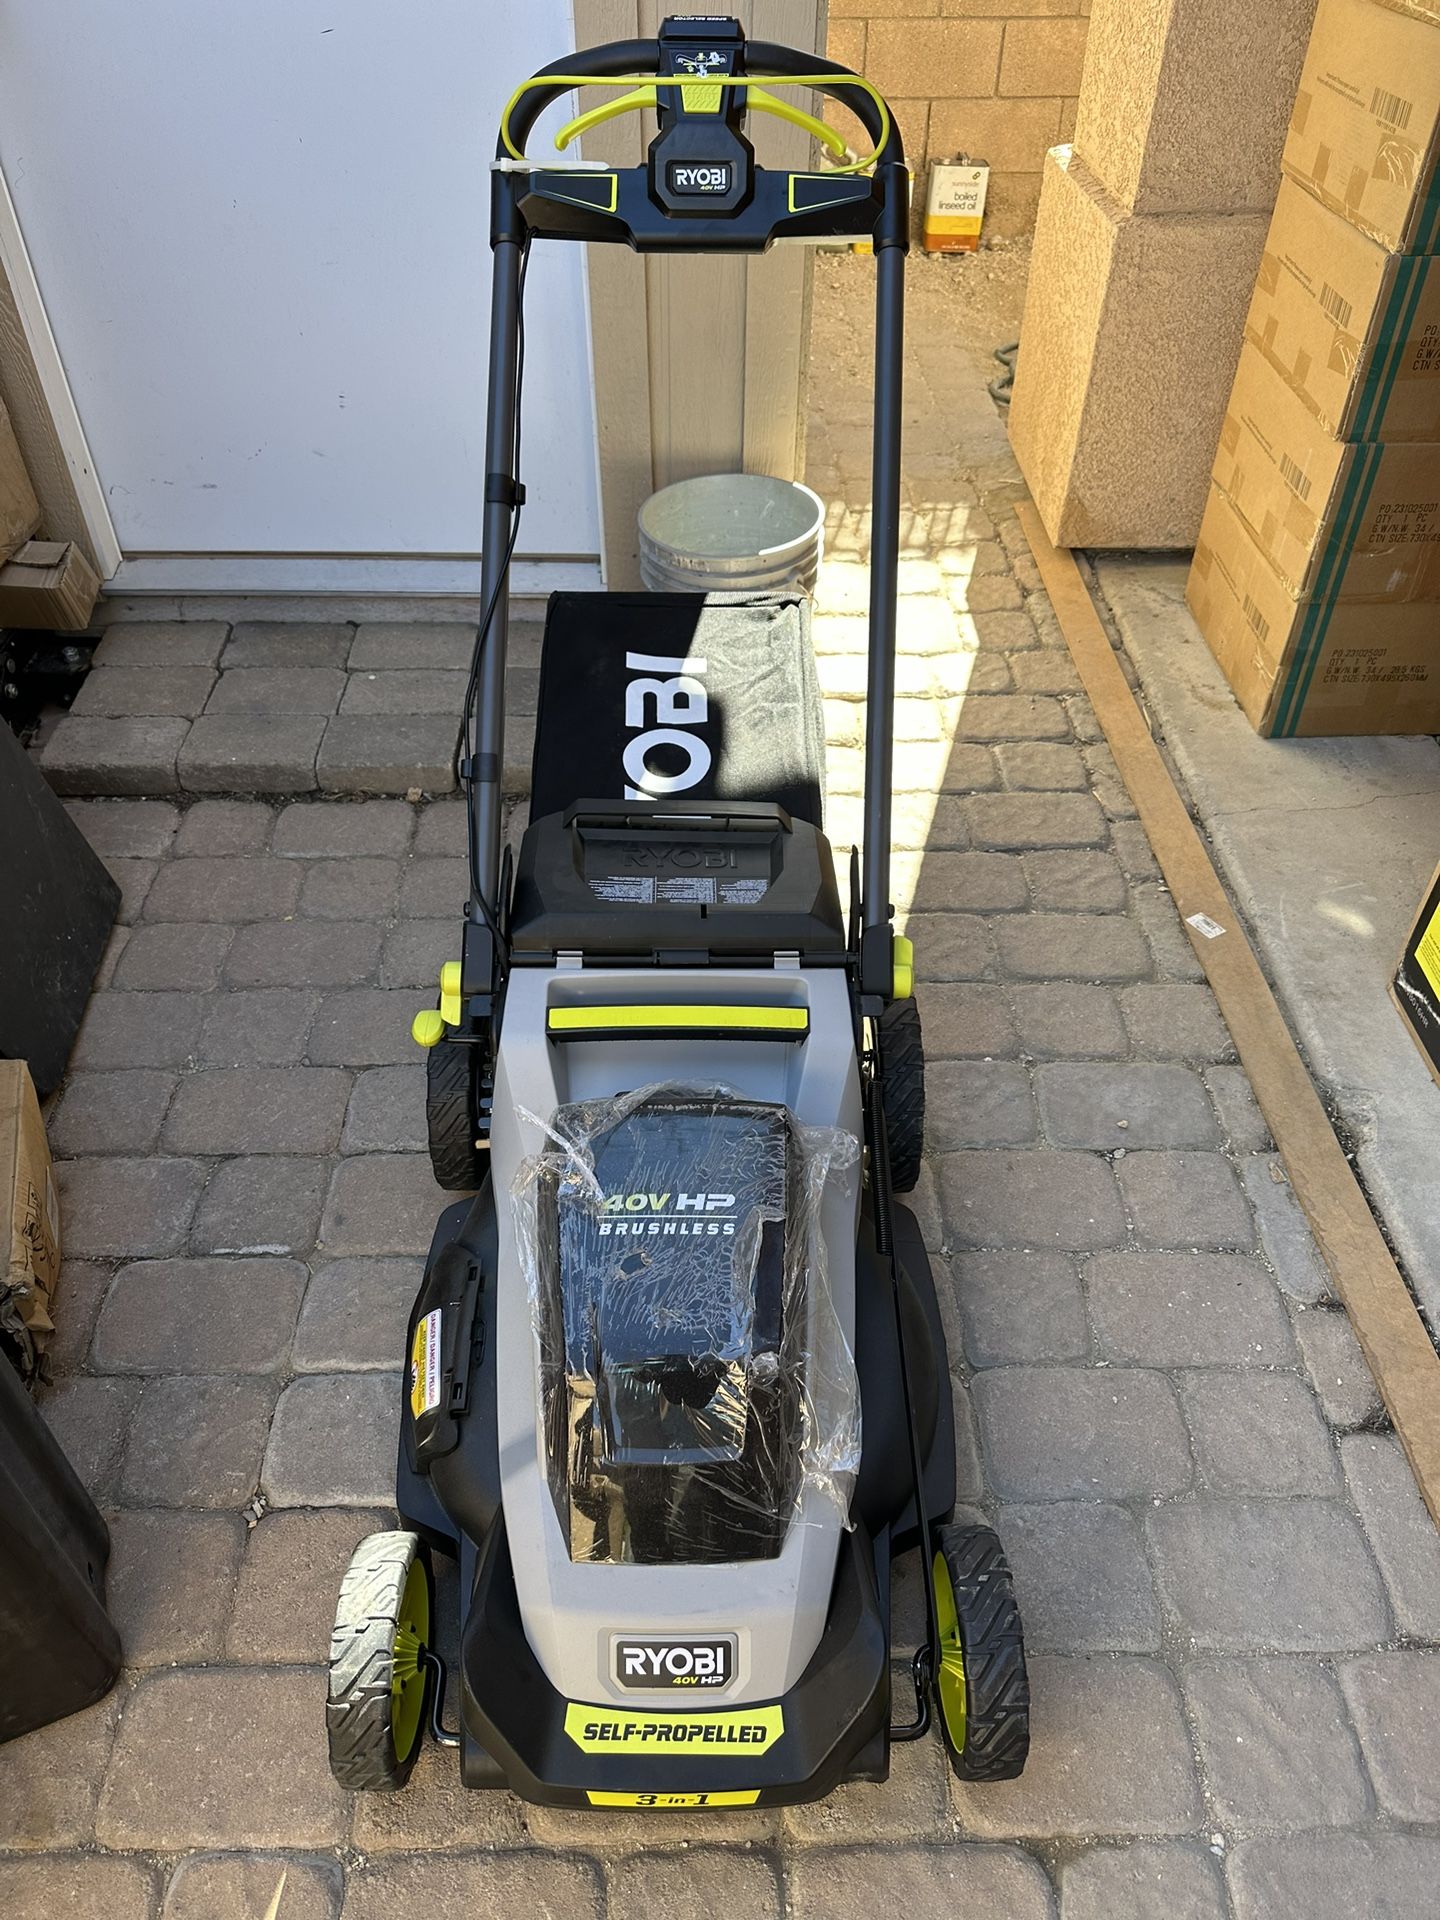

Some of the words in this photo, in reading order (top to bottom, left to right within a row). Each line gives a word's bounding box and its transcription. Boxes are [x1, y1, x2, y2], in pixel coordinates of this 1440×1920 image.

[675, 168, 726, 185] RYOBI
[954, 192, 978, 201] boiled
[939, 201, 966, 210] linseed
[967, 201, 976, 210] oil
[1413, 360, 1430, 371] CTN
[1416, 512, 1428, 522] PC
[1368, 533, 1386, 543] CTN
[1323, 675, 1339, 683] CTN
[624, 848, 738, 869] RYOBI
[602, 1193, 671, 1211] 40V
[676, 1193, 736, 1211] HP
[599, 1222, 736, 1235] BRUSHLESS
[623, 1647, 724, 1675] RYOBI
[672, 1676, 699, 1684] 40V
[700, 1676, 724, 1684] HP
[583, 1722, 768, 1743] SELF-PROPELLED
[635, 1794, 709, 1806] 3-in-1
